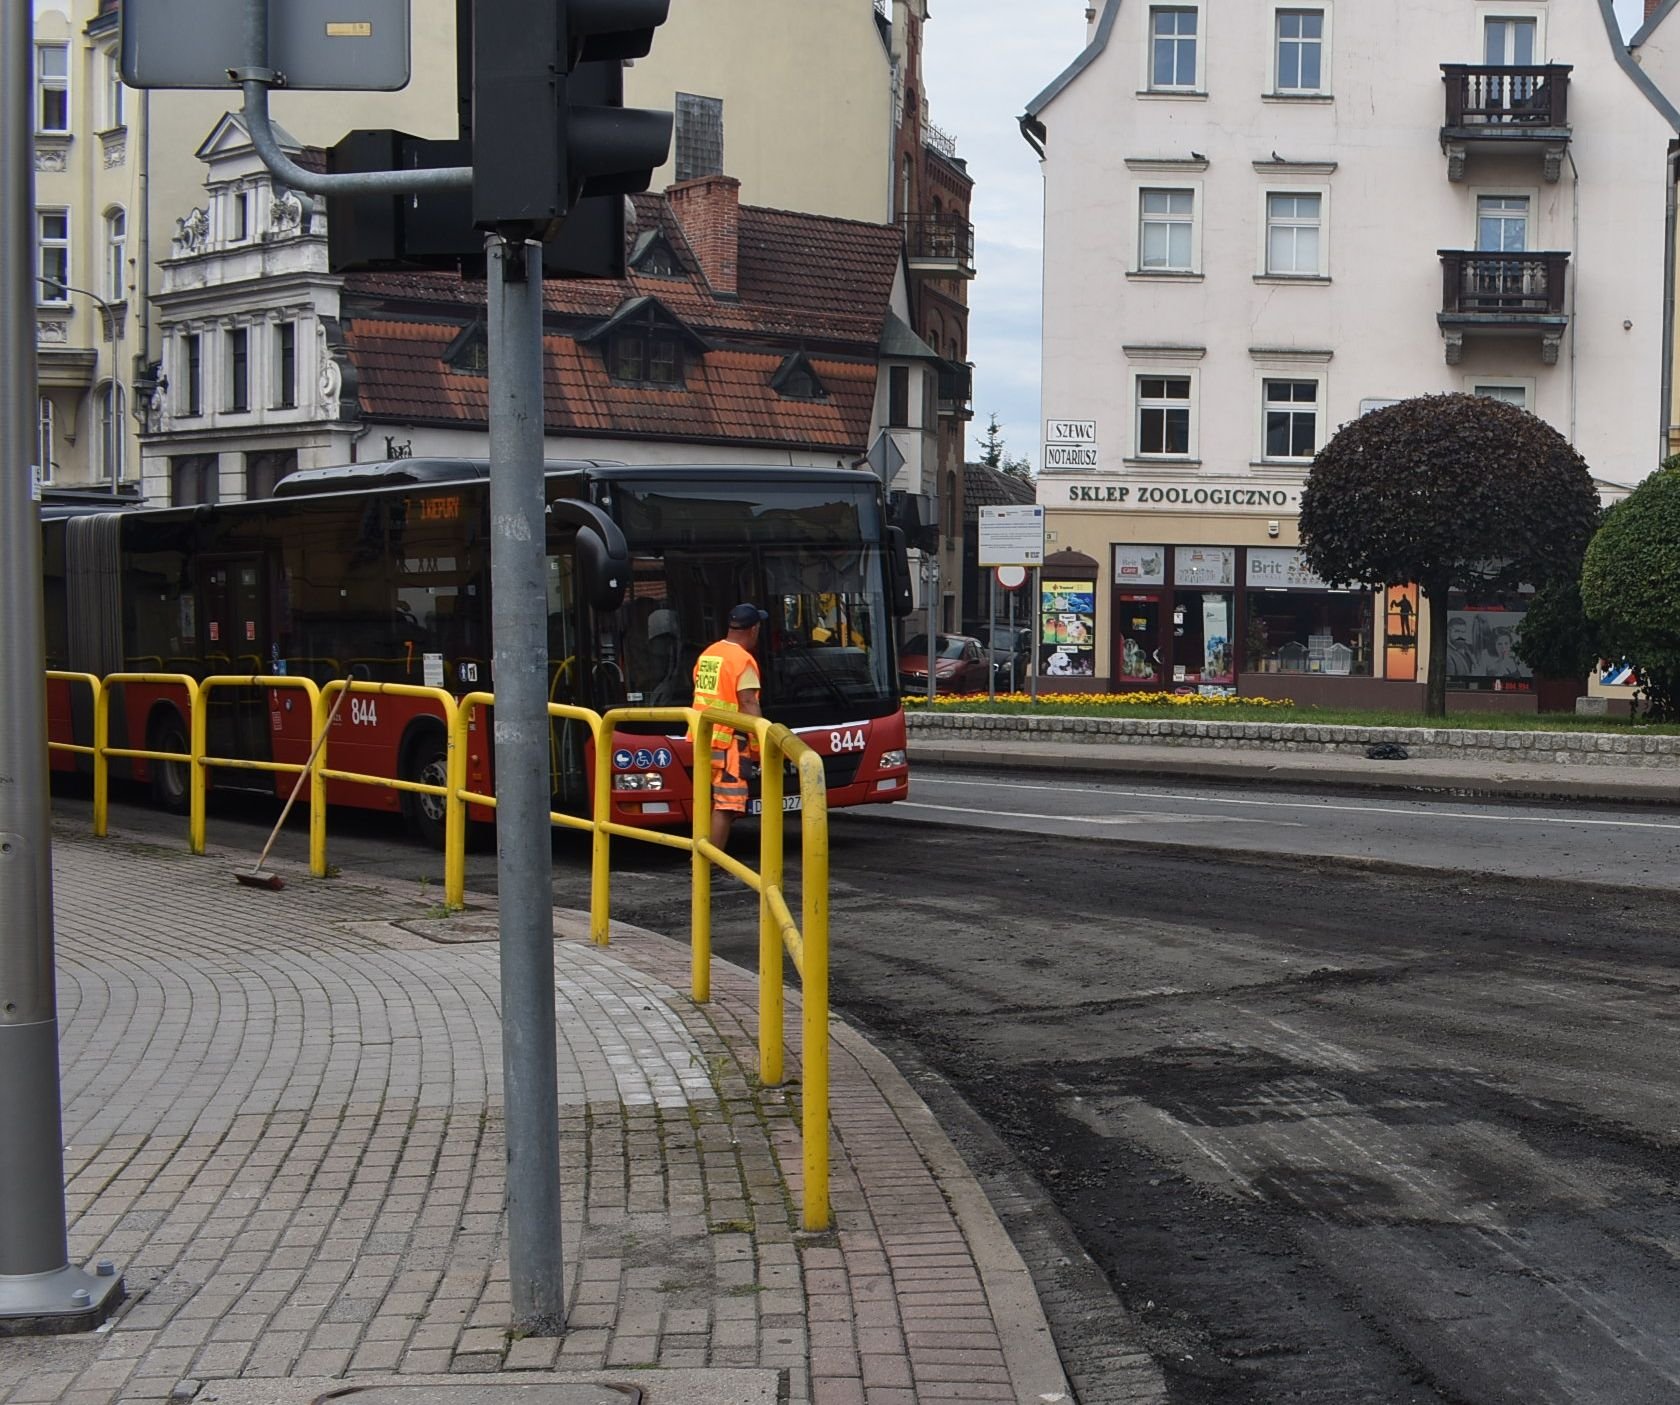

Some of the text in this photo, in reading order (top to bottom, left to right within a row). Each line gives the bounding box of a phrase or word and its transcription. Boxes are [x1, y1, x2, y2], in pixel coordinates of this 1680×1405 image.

[1055, 423, 1093, 439] SZEWC
[1048, 448, 1098, 466] NOTARIUSZ
[1069, 485, 1130, 502] SKLEP
[1137, 487, 1288, 505] ZOOLOGICZNO
[1251, 559, 1283, 575] Brit
[351, 697, 378, 727] 844
[830, 729, 866, 753] 844
